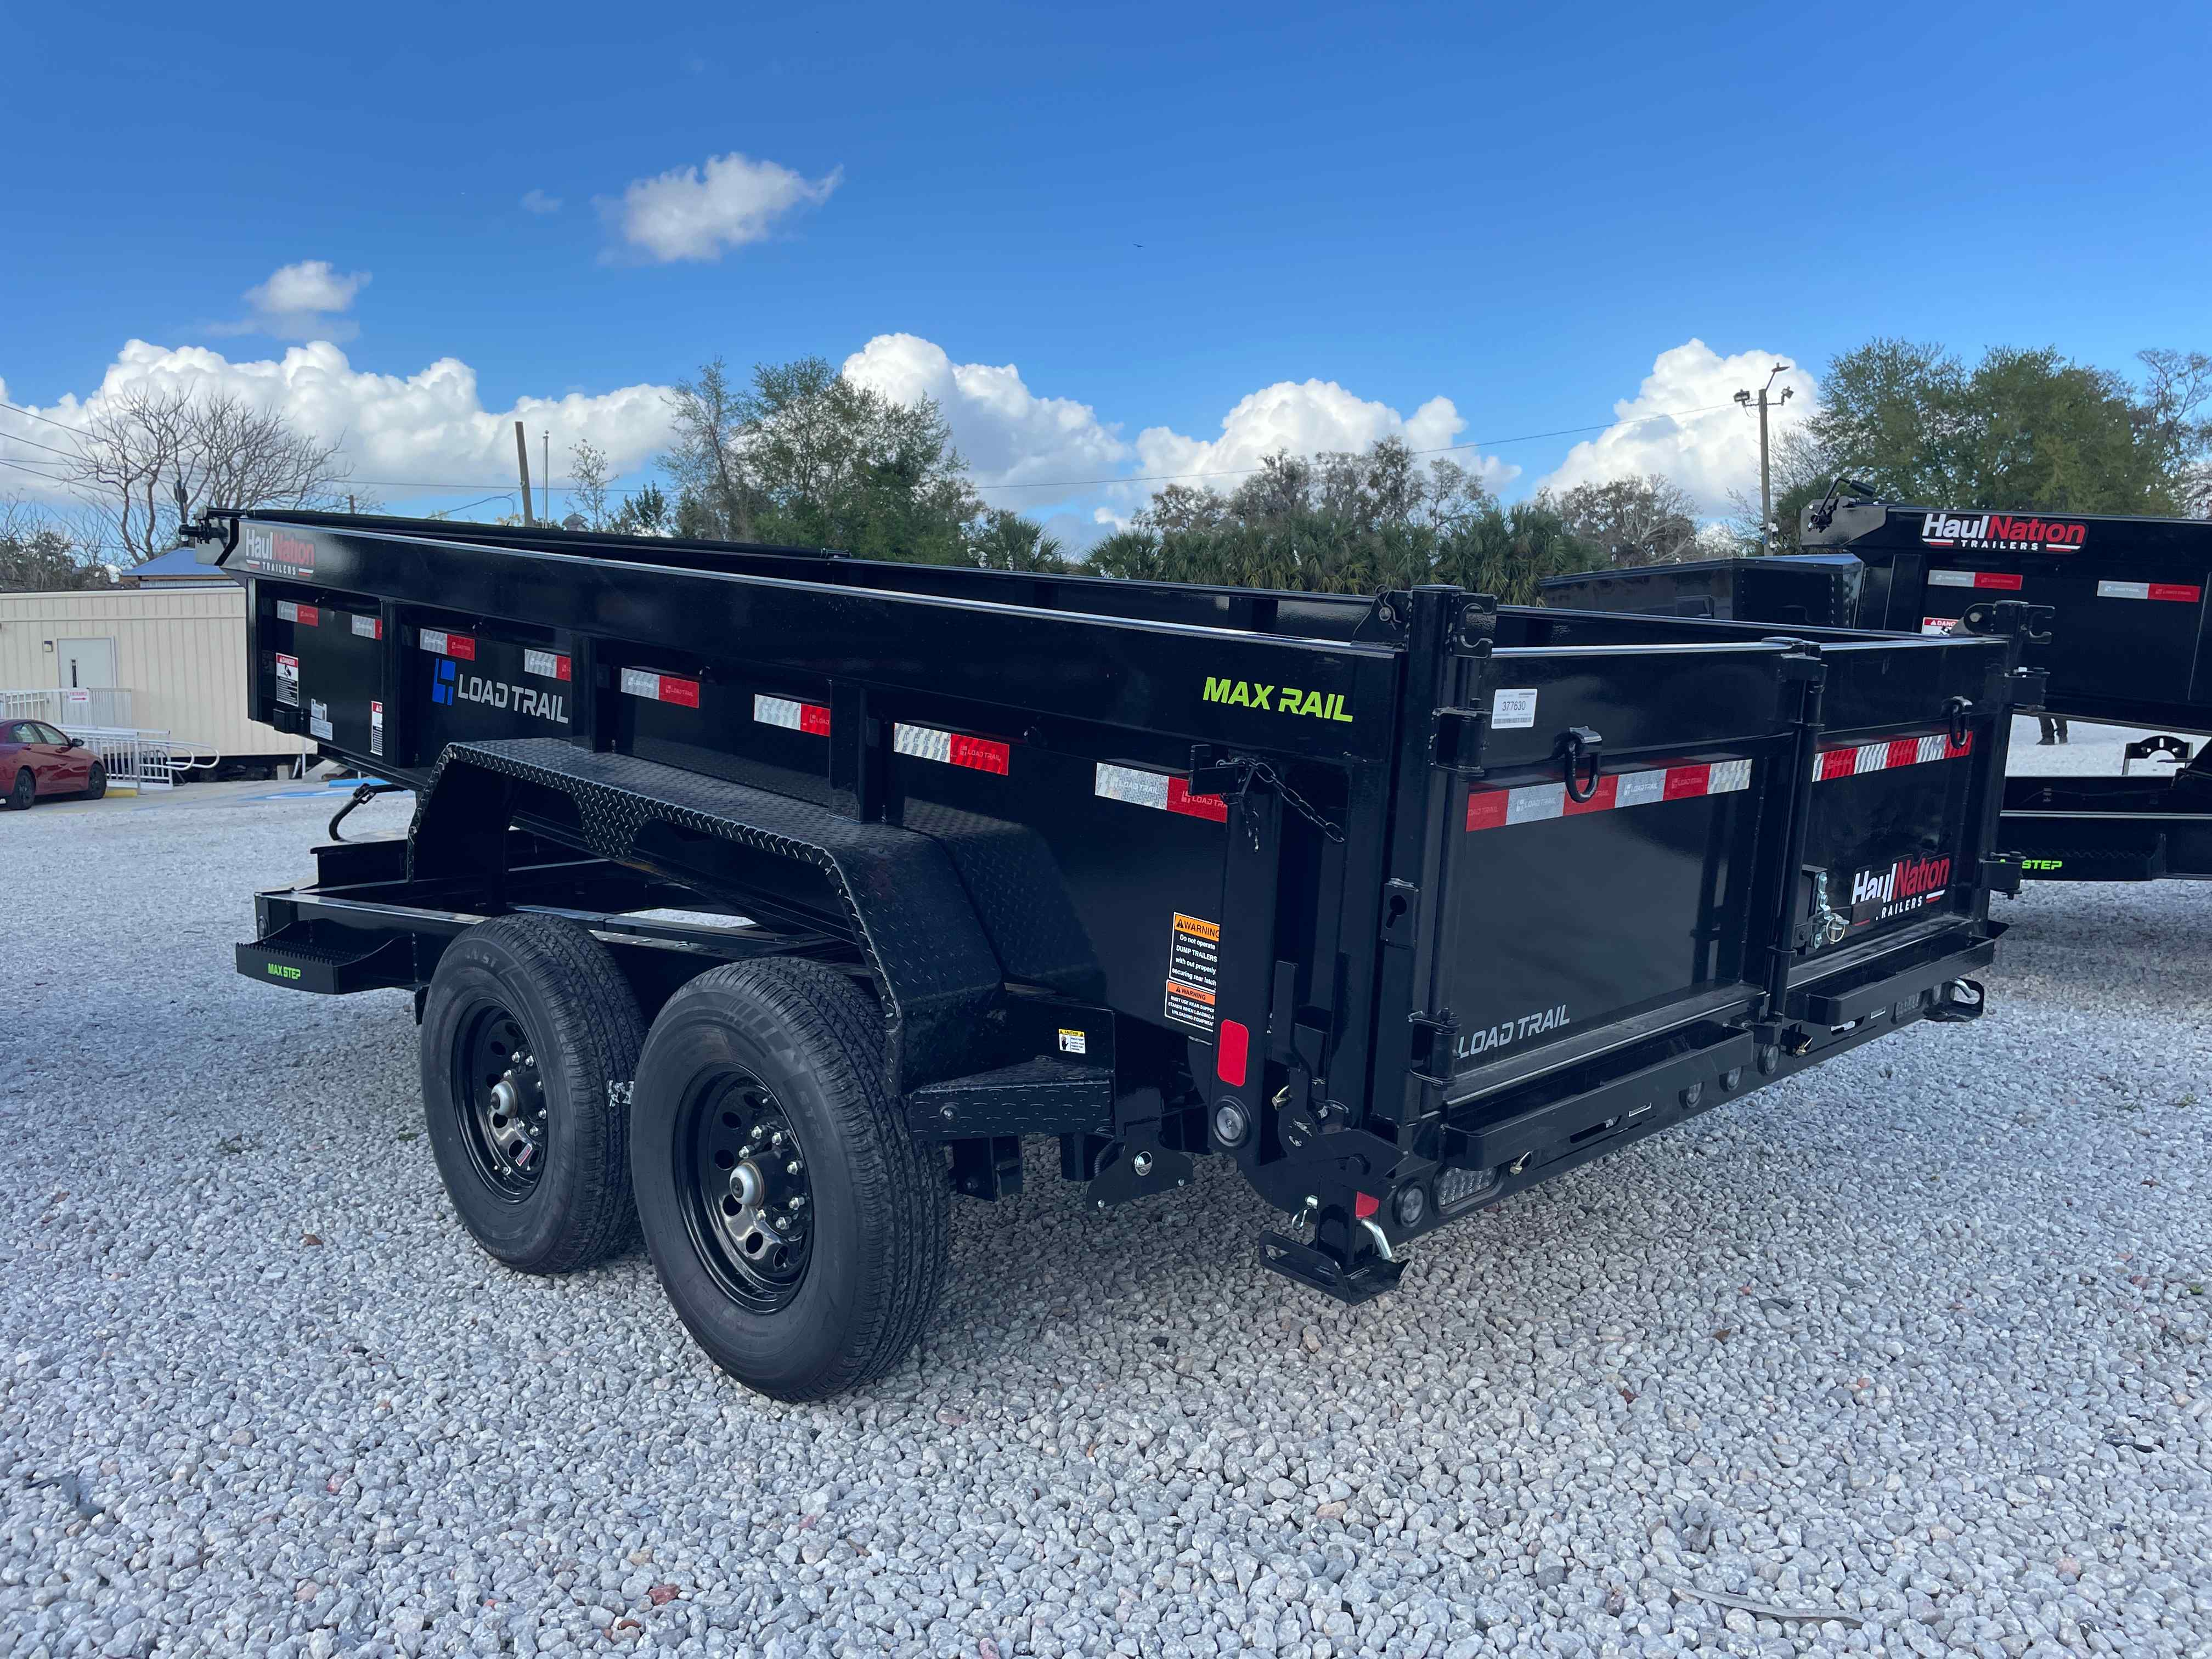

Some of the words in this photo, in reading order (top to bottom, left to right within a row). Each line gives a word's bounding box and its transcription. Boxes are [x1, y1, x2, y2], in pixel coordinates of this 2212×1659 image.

[1922, 514, 2085, 544] HaulNation
[1961, 539, 2039, 551] TRAILERS
[262, 561, 296, 575] TRAILERS
[458, 674, 509, 709] LOAD
[512, 685, 569, 724] TRAIL
[1203, 676, 1275, 710] MAX
[1278, 687, 1353, 723] RAIL
[1502, 701, 1526, 711] 377630
[2022, 860, 2063, 870] STEP
[1875, 895, 1923, 921] RAILERS
[1197, 940, 1216, 950] operate
[1175, 957, 1186, 965] with
[1176, 944, 1192, 954] DUMP
[1192, 949, 1217, 963] TRAILERS
[268, 963, 283, 977] MAX
[283, 966, 301, 979] STEP
[1172, 968, 1193, 980] securing
[1204, 977, 1216, 986] latch
[1181, 988, 1206, 1000] WARNING
[1194, 1009, 1211, 1019] LOADING
[1458, 1022, 1514, 1059] LOAD
[1517, 1005, 1570, 1040] TRAIL
